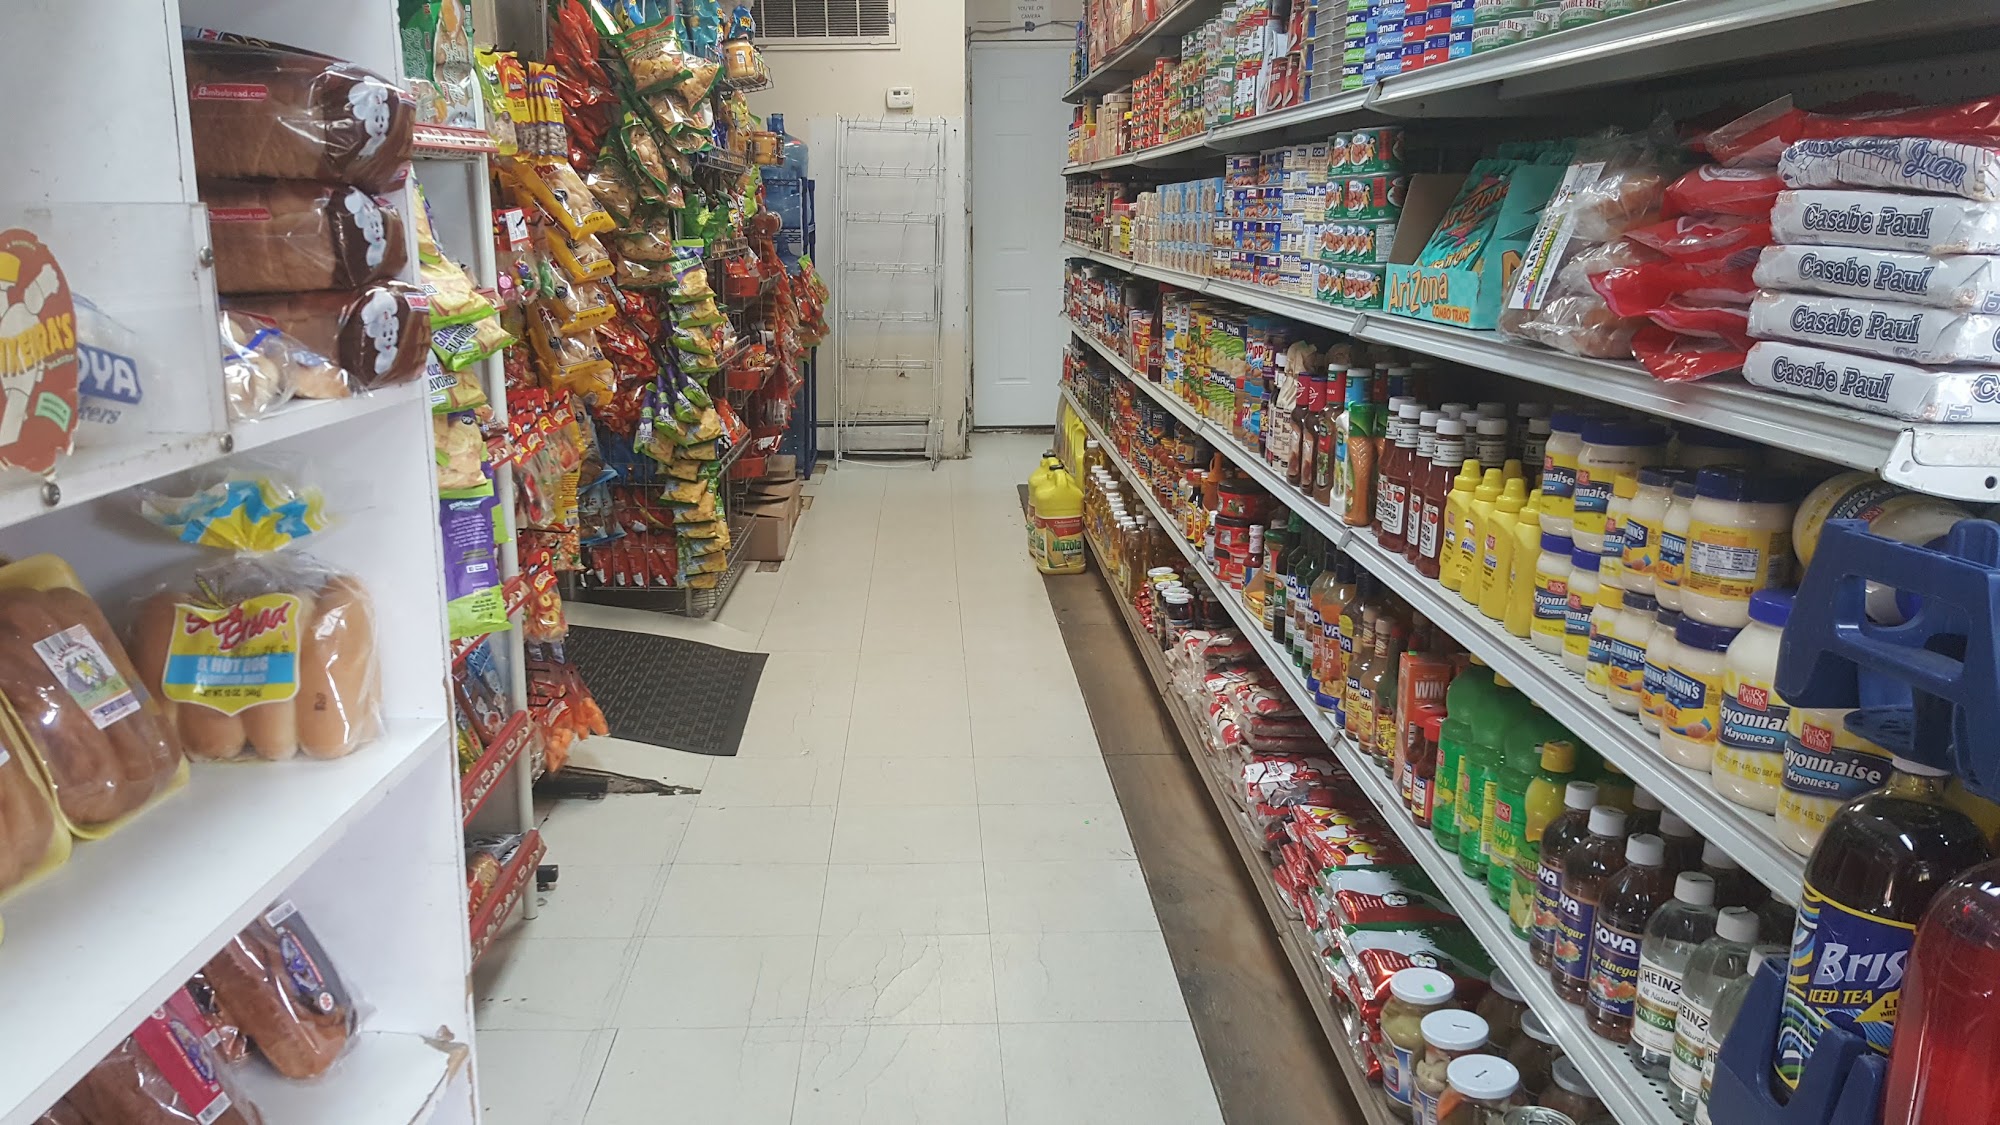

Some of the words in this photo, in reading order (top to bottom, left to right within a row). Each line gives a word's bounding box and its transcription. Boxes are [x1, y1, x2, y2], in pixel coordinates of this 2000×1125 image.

[1902, 140, 1968, 187] Juan
[1801, 202, 1874, 234] Casabe
[1875, 206, 1934, 240] Paul
[1797, 252, 1871, 286] Casabe
[1873, 262, 1935, 293] Paul
[1388, 268, 1449, 315] AriZona
[1432, 303, 1451, 319] COMBO
[1452, 307, 1470, 324] TRAYS
[1789, 305, 1863, 338] Casabe
[1867, 310, 1924, 344] Paul
[1770, 355, 1838, 390] Casabe
[1839, 365, 1895, 404] Paul
[1052, 539, 1082, 552] Mazola
[1742, 694, 1765, 708] White
[1723, 725, 1776, 746] Mayonesa
[1805, 734, 1828, 750] White
[1786, 768, 1841, 791] Mayonesa
[1643, 969, 1681, 995] HEINZ
[1650, 991, 1680, 1008] Natural
[1807, 989, 1839, 1005] ICED
[1842, 989, 1873, 1005] TEA
[1681, 1026, 1706, 1045] Natural
